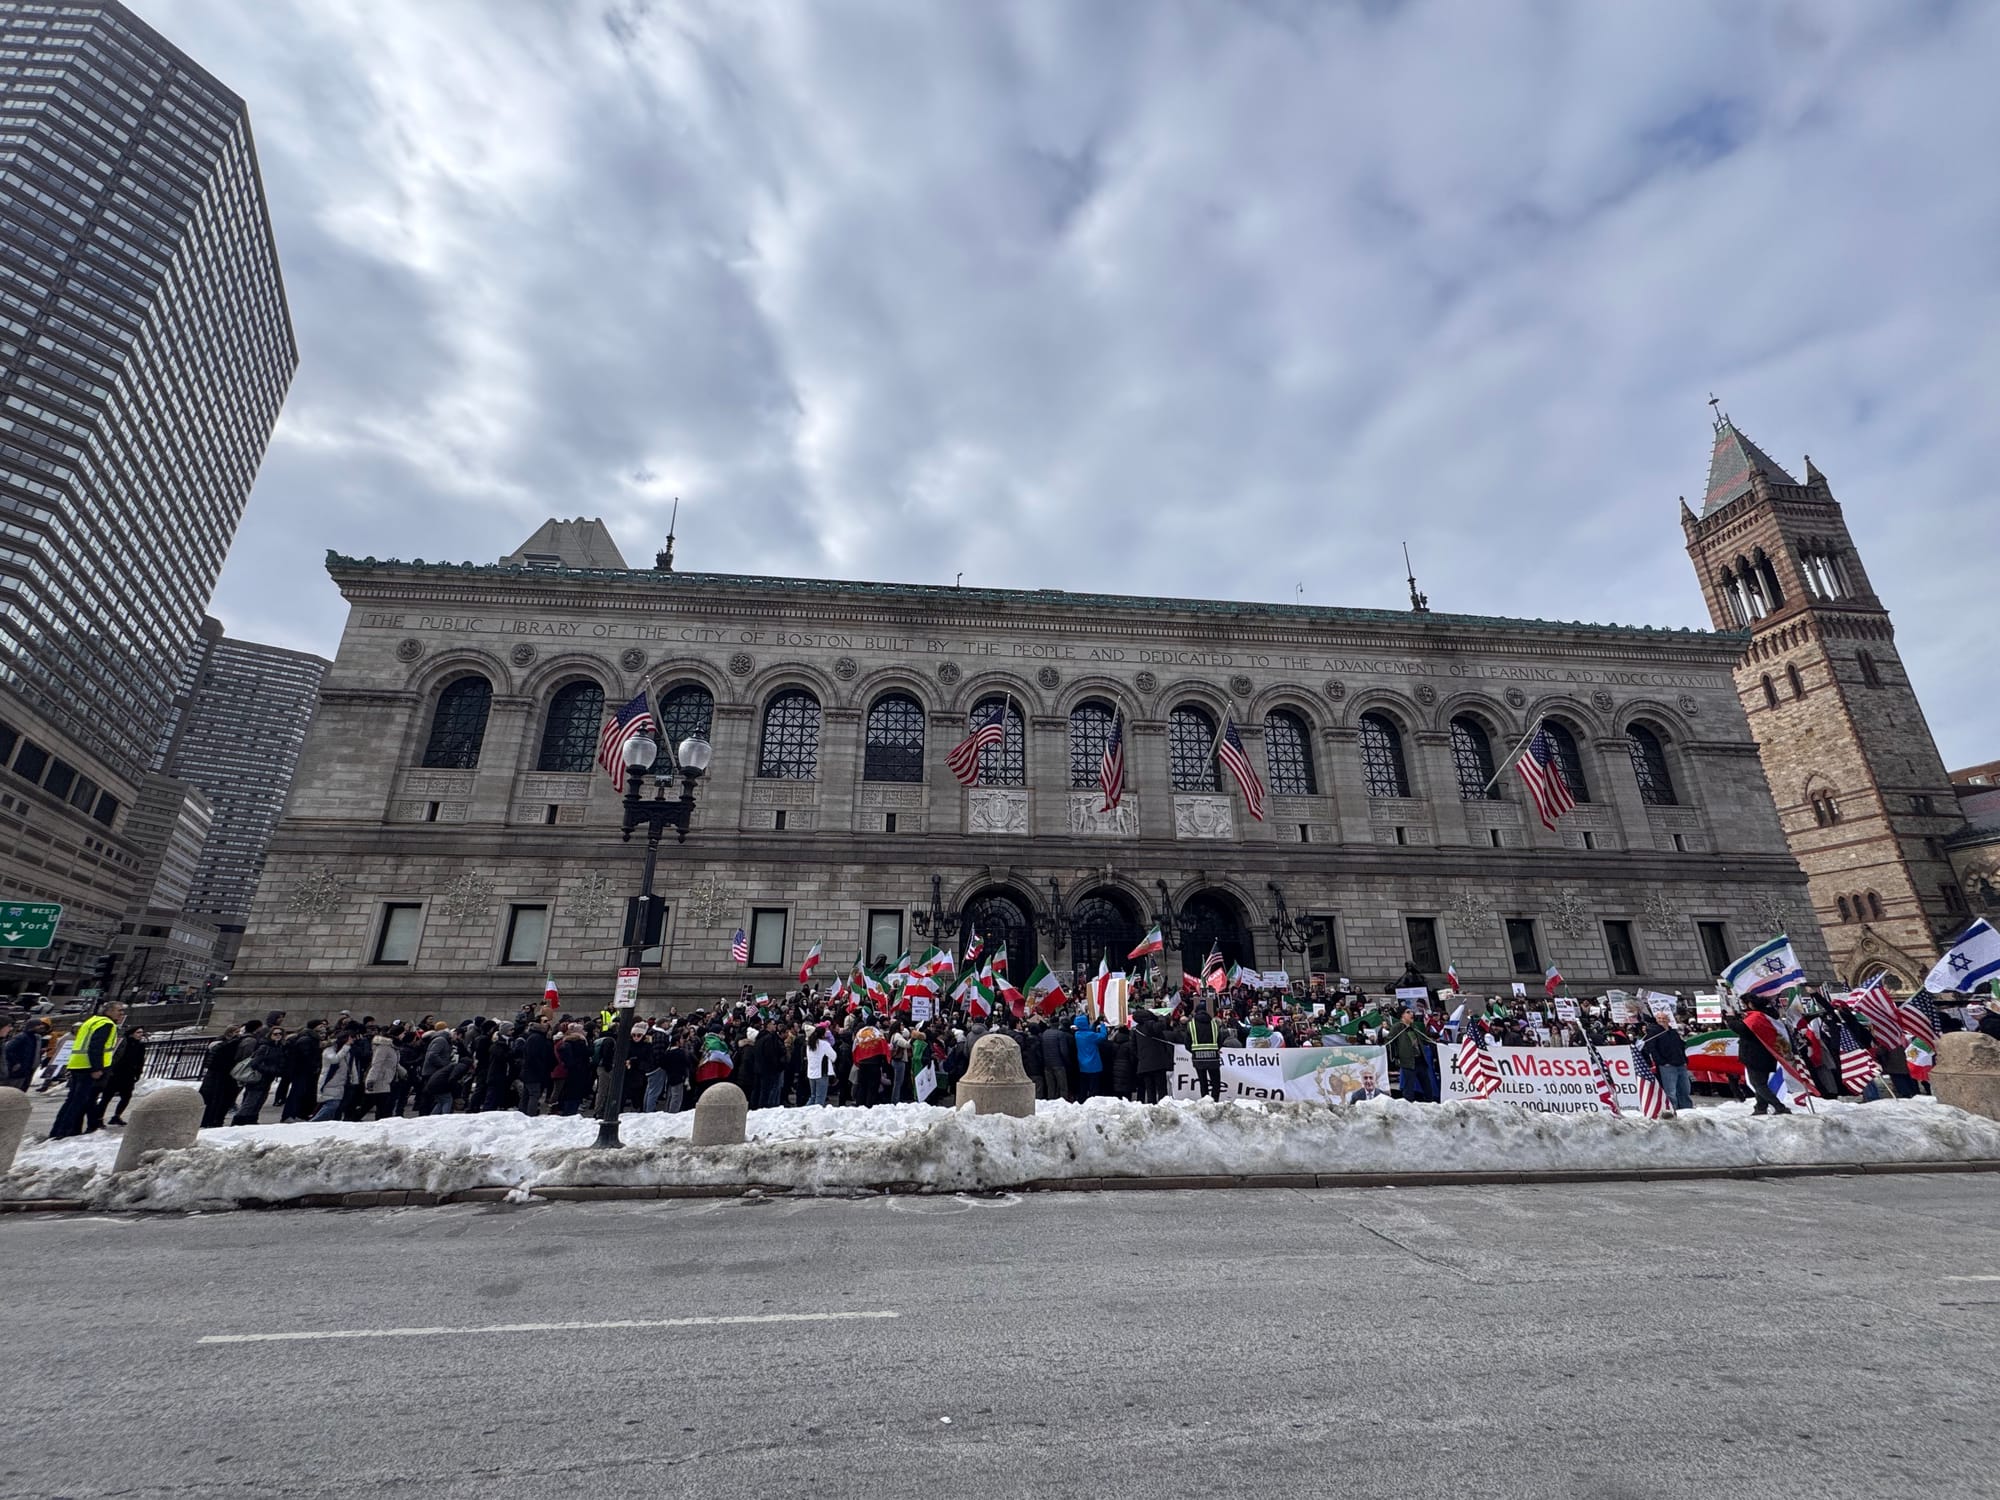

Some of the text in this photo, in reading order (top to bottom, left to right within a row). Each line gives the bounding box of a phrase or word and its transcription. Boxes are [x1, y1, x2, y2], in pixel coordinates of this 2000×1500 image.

[368, 614, 404, 628] THE
[420, 616, 484, 632] PUBLIC
[500, 620, 581, 636] LIBRARY
[592, 624, 618, 637] OF
[634, 626, 668, 640] THE
[680, 628, 728, 642] CITY
[740, 631, 764, 644] OF
[776, 633, 852, 648] BOSTON
[866, 637, 914, 652] BUILT
[928, 640, 950, 653] BY
[964, 642, 1000, 656] THE
[1012, 644, 1076, 659] PEOPLE
[1090, 648, 1125, 662] AND
[1140, 650, 1232, 666] DEDICATED
[1247, 656, 1270, 667] TO
[1280, 656, 1312, 670] THE
[1323, 660, 1438, 675] ADVANCEMENT
[1450, 664, 1470, 676] OF
[1481, 666, 1558, 681] LEARNING
[20, 922, 49, 930] York
[1228, 1053, 1280, 1067] Pahlavi
[1178, 1074, 1284, 1101] Fre Iran
[1544, 1083, 1582, 1095] 10,000
